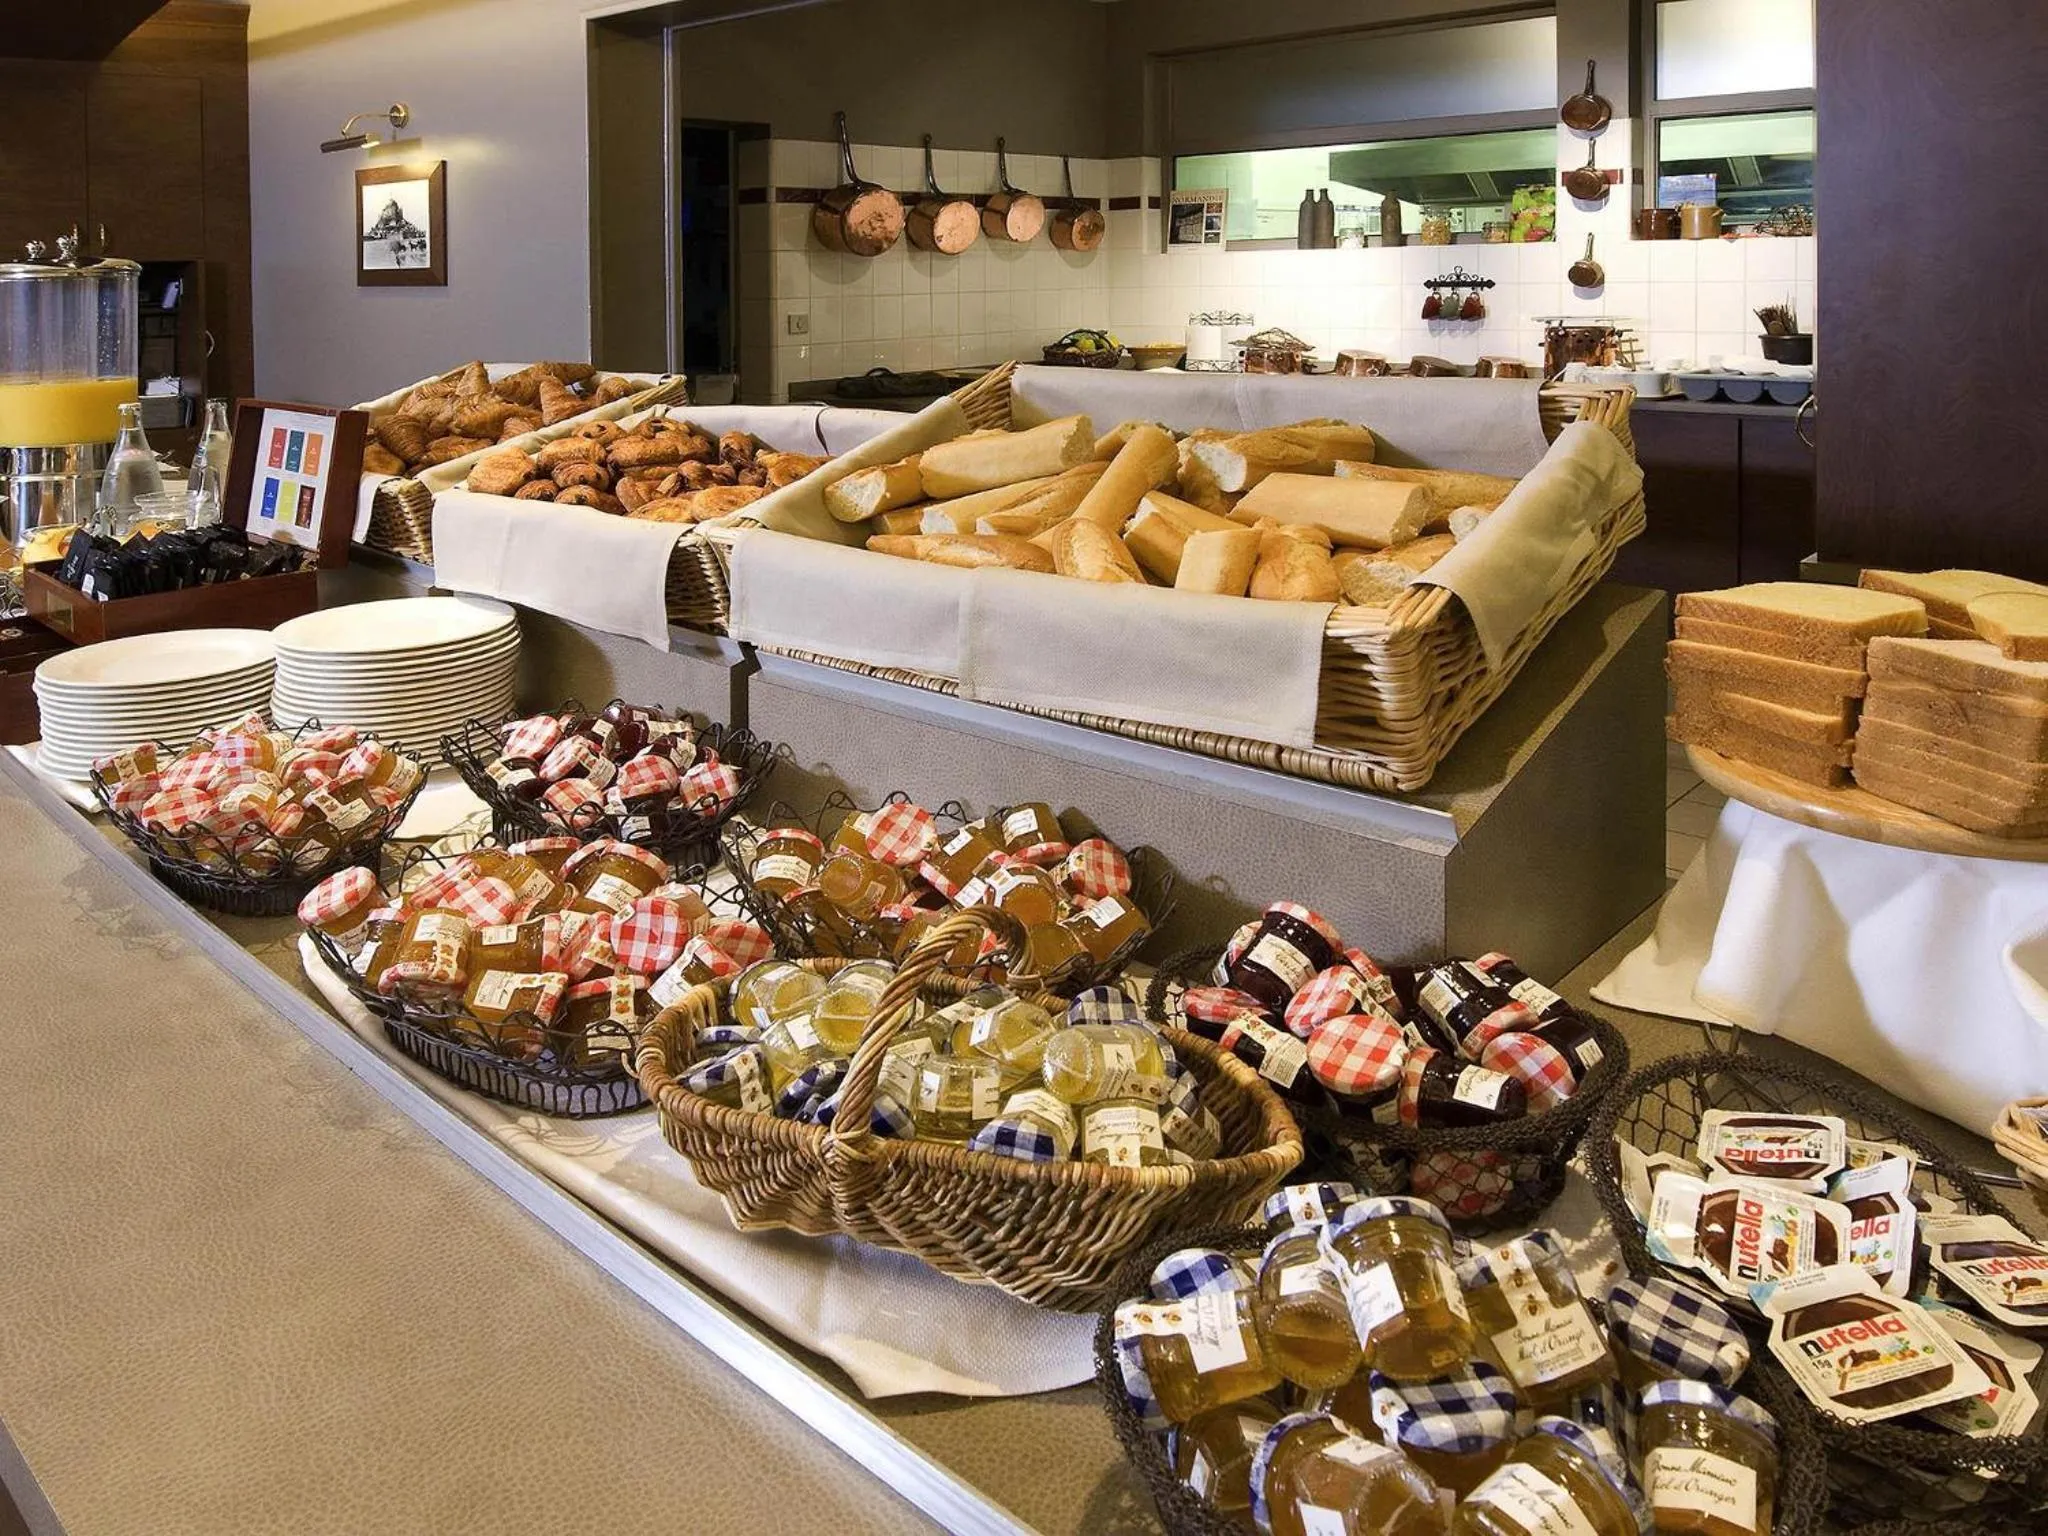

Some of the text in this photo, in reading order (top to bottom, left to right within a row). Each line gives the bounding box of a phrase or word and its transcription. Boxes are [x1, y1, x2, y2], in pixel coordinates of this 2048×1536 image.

[1725, 1147, 1821, 1164] nutella
[1735, 1200, 1765, 1280] nutella
[1850, 1217, 1890, 1240] ella
[1799, 1317, 1909, 1358] nutella
[1812, 1359, 1833, 1371] 15g
